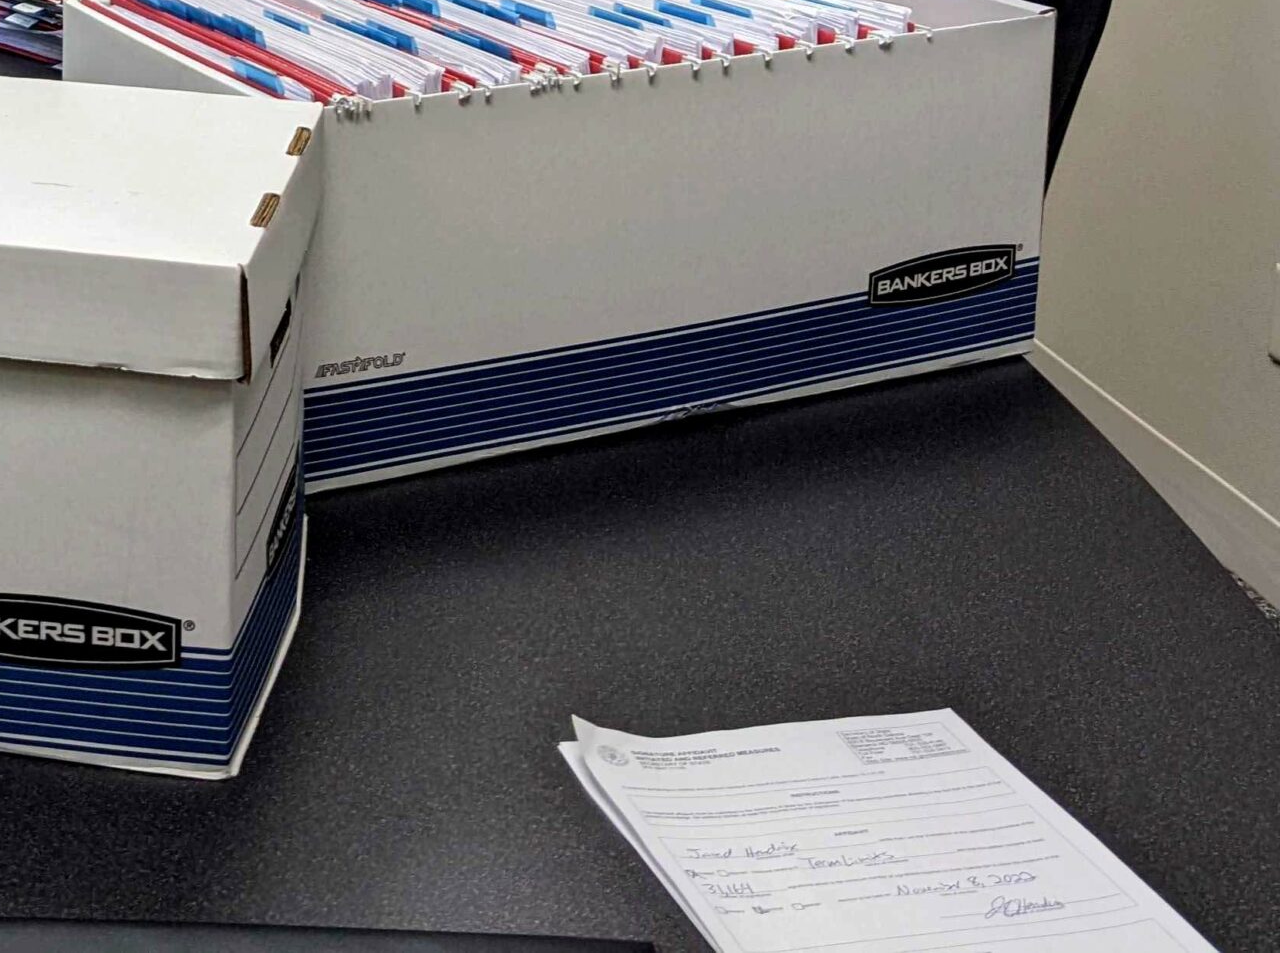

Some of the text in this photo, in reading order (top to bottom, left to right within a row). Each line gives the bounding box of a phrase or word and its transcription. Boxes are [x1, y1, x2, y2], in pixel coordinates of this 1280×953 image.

[877, 256, 1009, 295] BANKERS BOX
[91, 626, 167, 651] BOX
